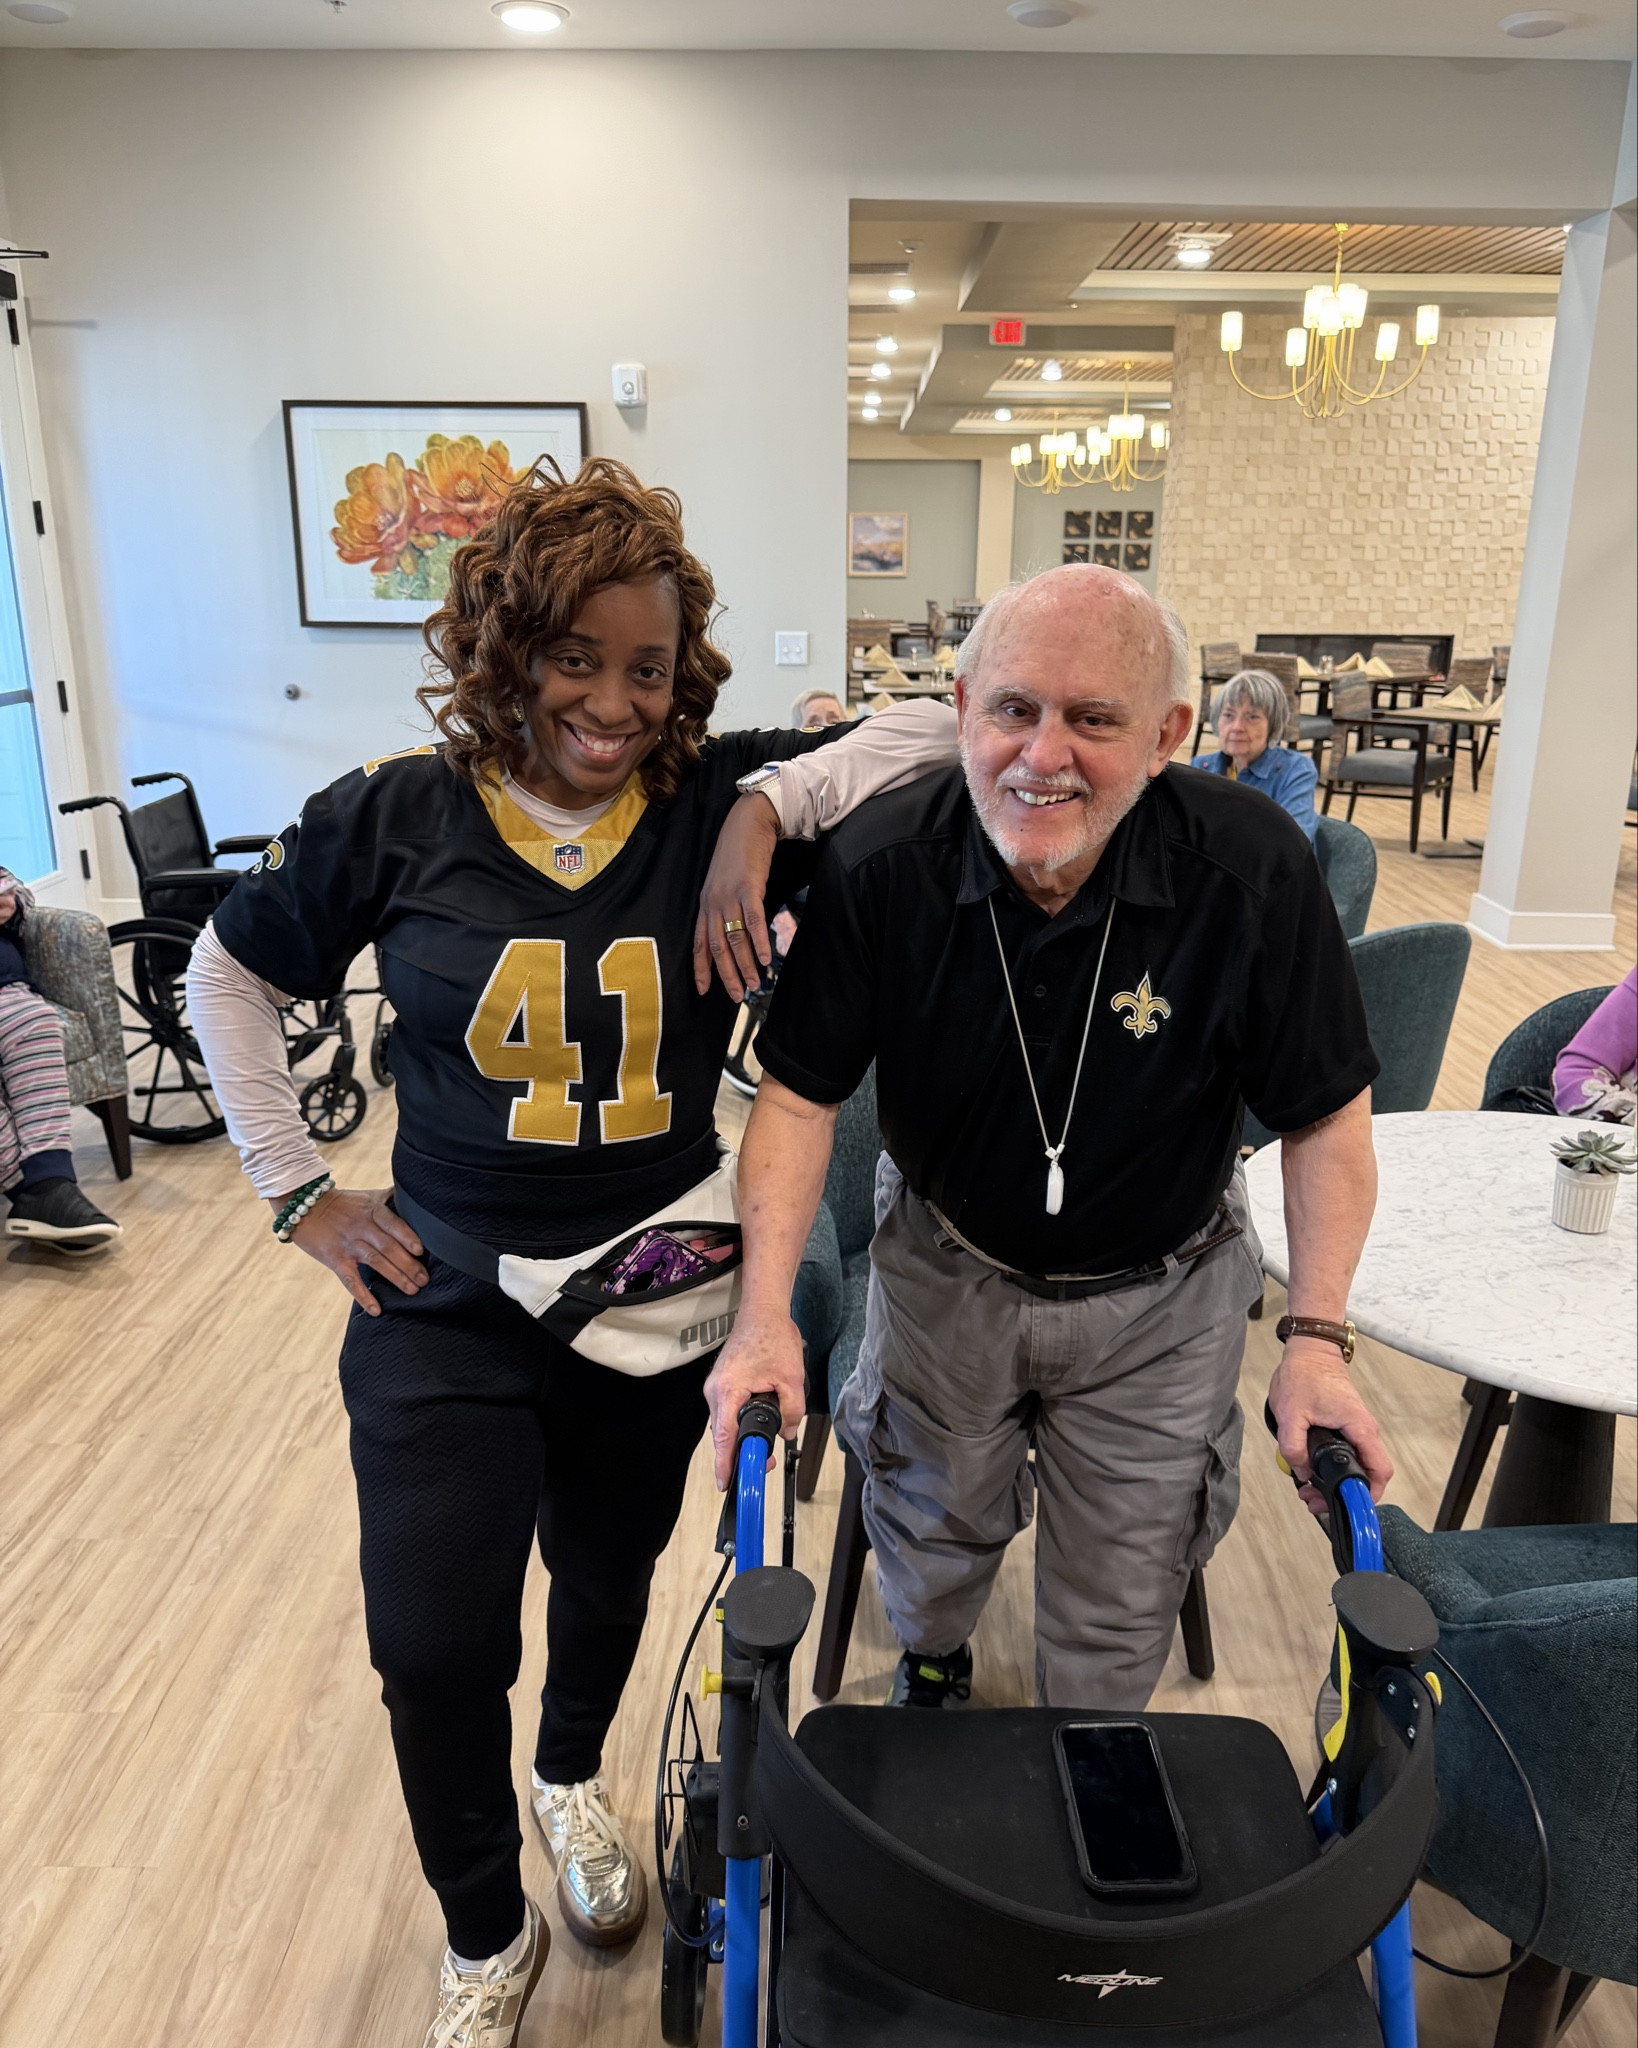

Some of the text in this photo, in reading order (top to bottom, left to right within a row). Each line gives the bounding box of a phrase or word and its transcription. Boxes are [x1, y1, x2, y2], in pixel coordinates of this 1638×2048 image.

[559, 855, 580, 869] NFL
[464, 937, 672, 1146] 41
[680, 1311, 737, 1353] PUM
[1057, 1972, 1163, 1988] MEDLINE
